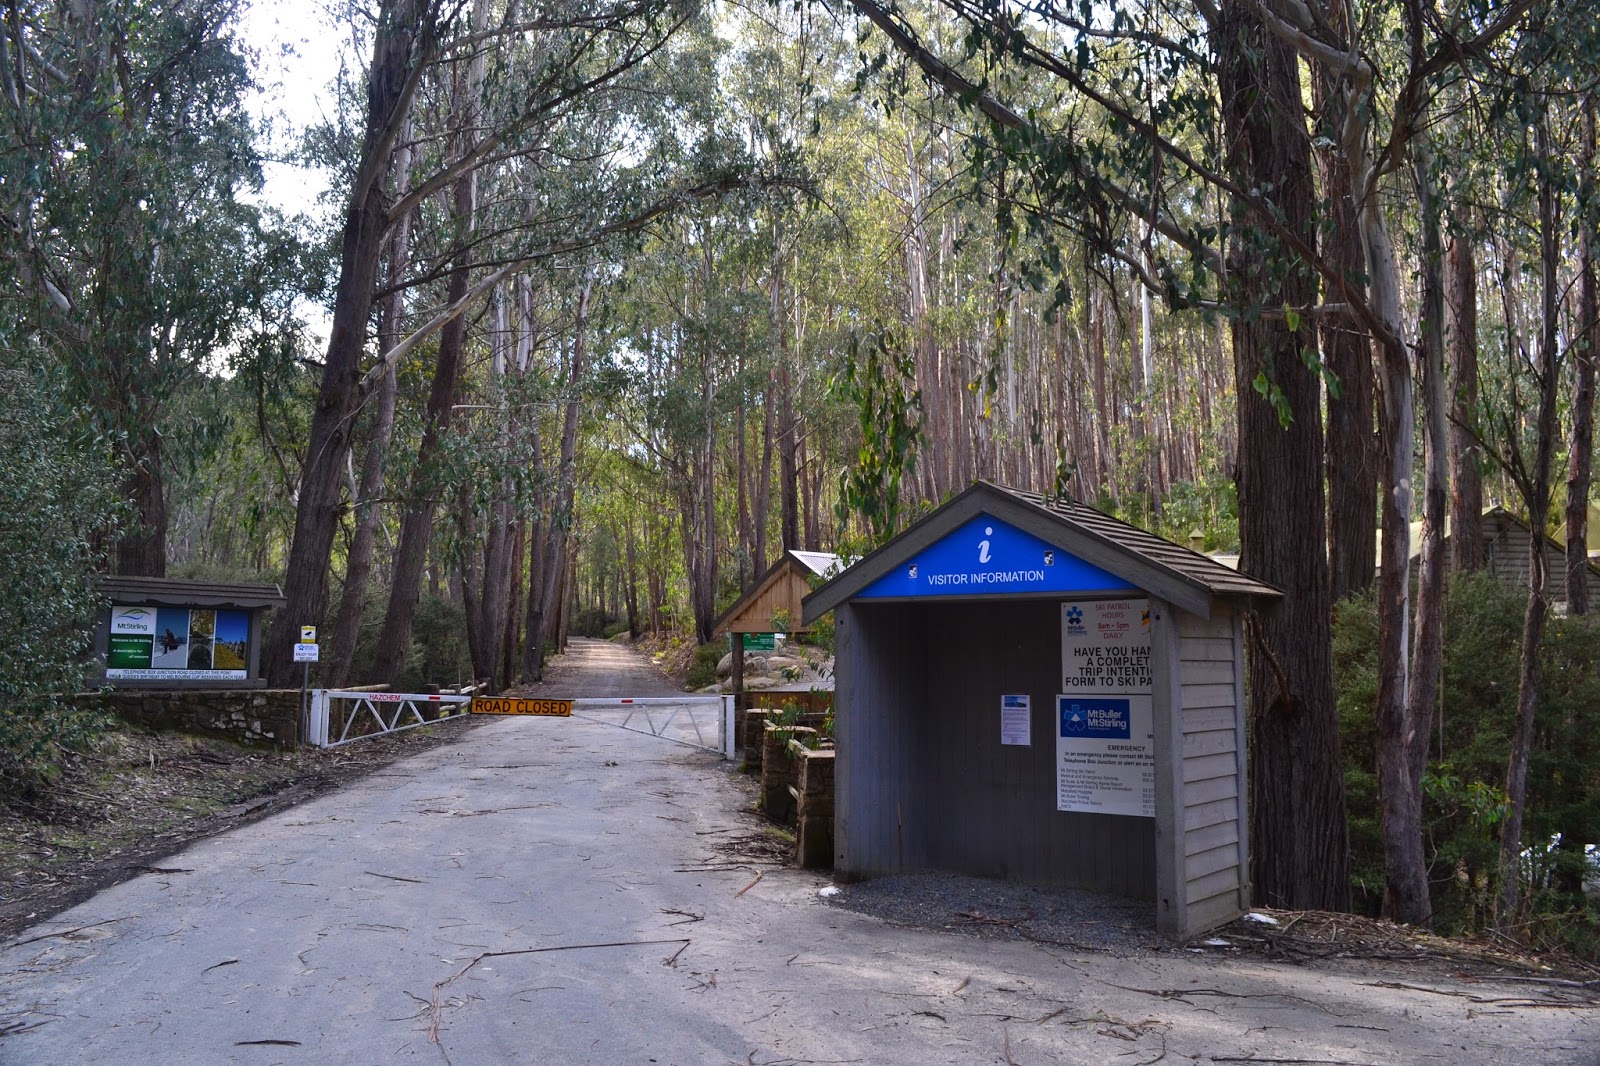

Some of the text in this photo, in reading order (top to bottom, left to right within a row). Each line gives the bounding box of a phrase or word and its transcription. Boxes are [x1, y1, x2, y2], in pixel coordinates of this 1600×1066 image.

[928, 570, 1044, 585] VISITOR INFORMATION
[1074, 647, 1102, 656] HAVE
[1105, 646, 1127, 656] YOU
[1087, 656, 1149, 666] A COMPLET
[1079, 667, 1152, 676] TRIP INTENTI
[1066, 677, 1096, 686] FORM
[1100, 677, 1114, 686] TO
[1118, 677, 1135, 686] SKI
[475, 700, 567, 714] ROAD CLOSED
